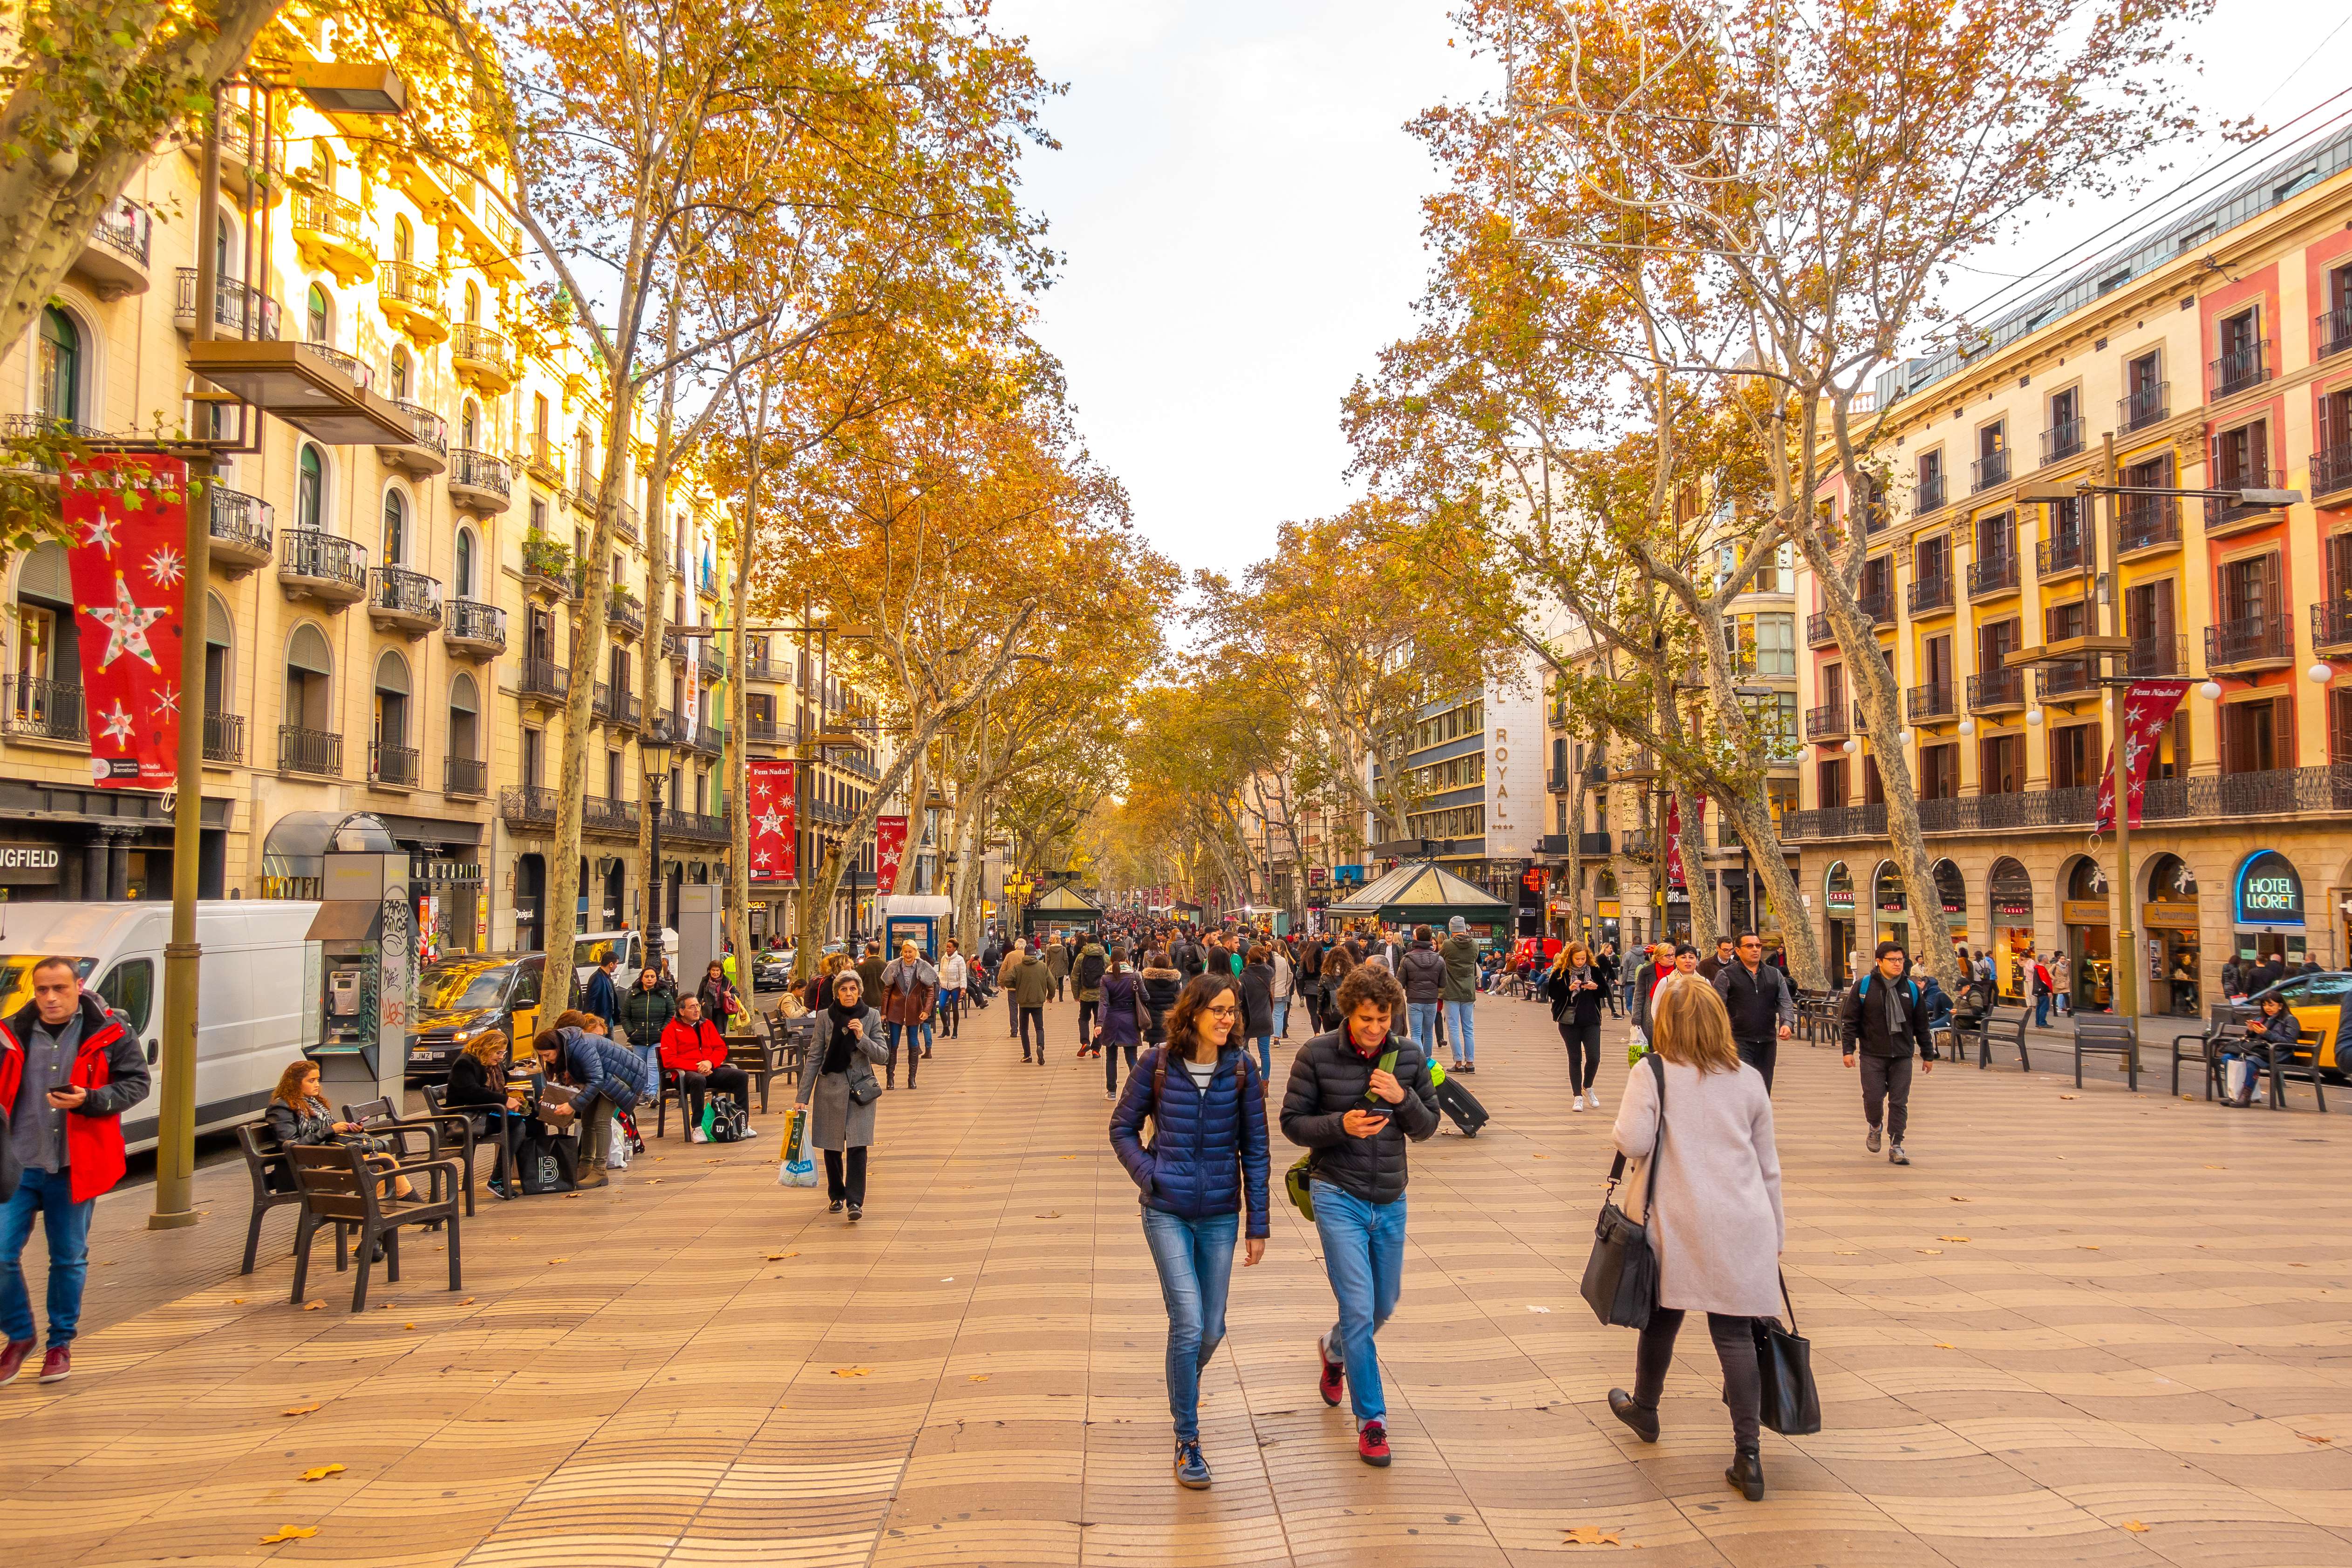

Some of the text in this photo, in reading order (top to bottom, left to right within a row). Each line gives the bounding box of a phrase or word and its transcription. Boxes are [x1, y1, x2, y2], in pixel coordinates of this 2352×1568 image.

[1495, 728, 1508, 817] ROYAL
[263, 875, 320, 900] HOTEL
[2249, 878, 2294, 893] HOTEL
[1667, 891, 1679, 903] ans
[2246, 893, 2296, 909] LLORET
[539, 1156, 559, 1183] B
